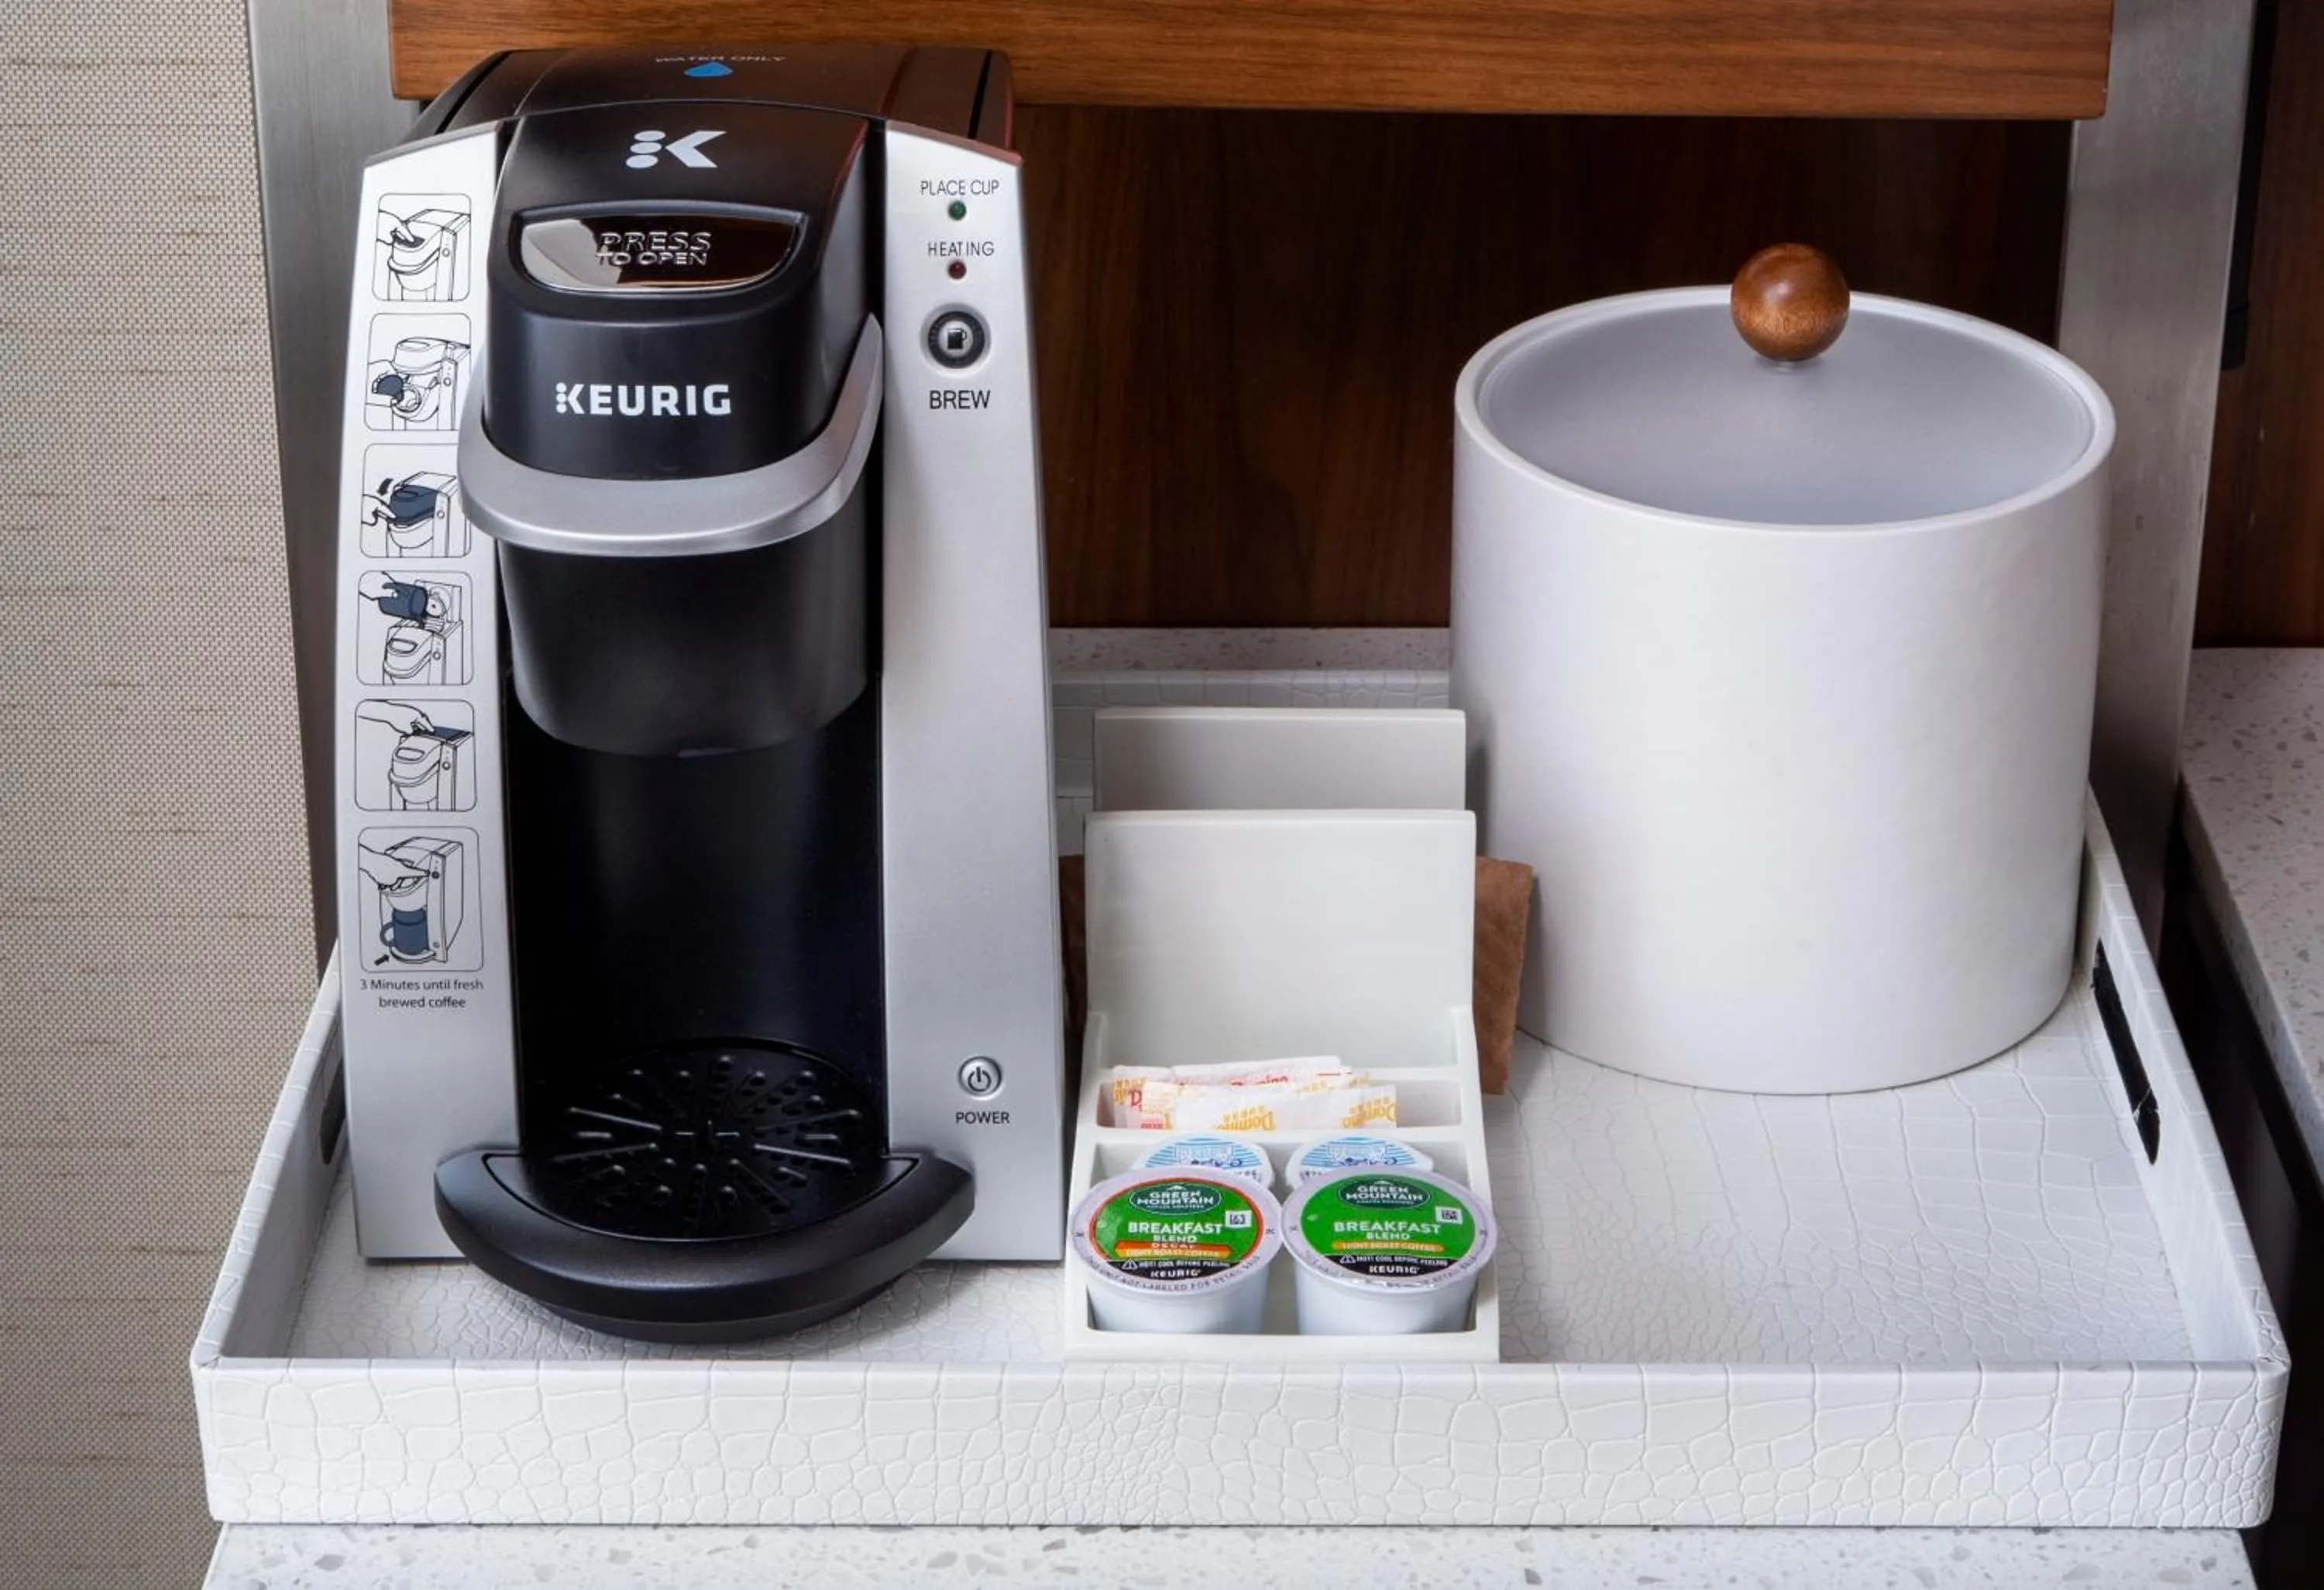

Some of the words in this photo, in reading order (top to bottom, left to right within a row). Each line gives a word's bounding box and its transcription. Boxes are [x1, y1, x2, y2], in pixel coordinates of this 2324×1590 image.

[920, 179, 966, 196] PLACE
[970, 179, 1000, 195] CUP
[600, 231, 712, 251] PRESS
[927, 241, 995, 256] HEATING
[596, 252, 631, 265] TO
[638, 252, 707, 265] OPEN
[555, 382, 732, 416] KEURIG
[929, 389, 991, 410] BREW
[359, 979, 368, 991] 3
[370, 979, 421, 991] Minutes
[423, 979, 450, 990] until
[453, 979, 484, 991] fresh
[379, 996, 425, 1008] brewed
[428, 996, 466, 1008] coffee
[955, 1111, 1010, 1124] POWER
[1128, 1222, 1222, 1234] BREAKFAST
[1334, 1220, 1441, 1234] BREAKFAST
[1153, 1234, 1198, 1243] BLEND
[1366, 1231, 1410, 1240] BLEND
[1150, 1268, 1198, 1278] KEURIG
[1369, 1265, 1418, 1274] KEURIG
